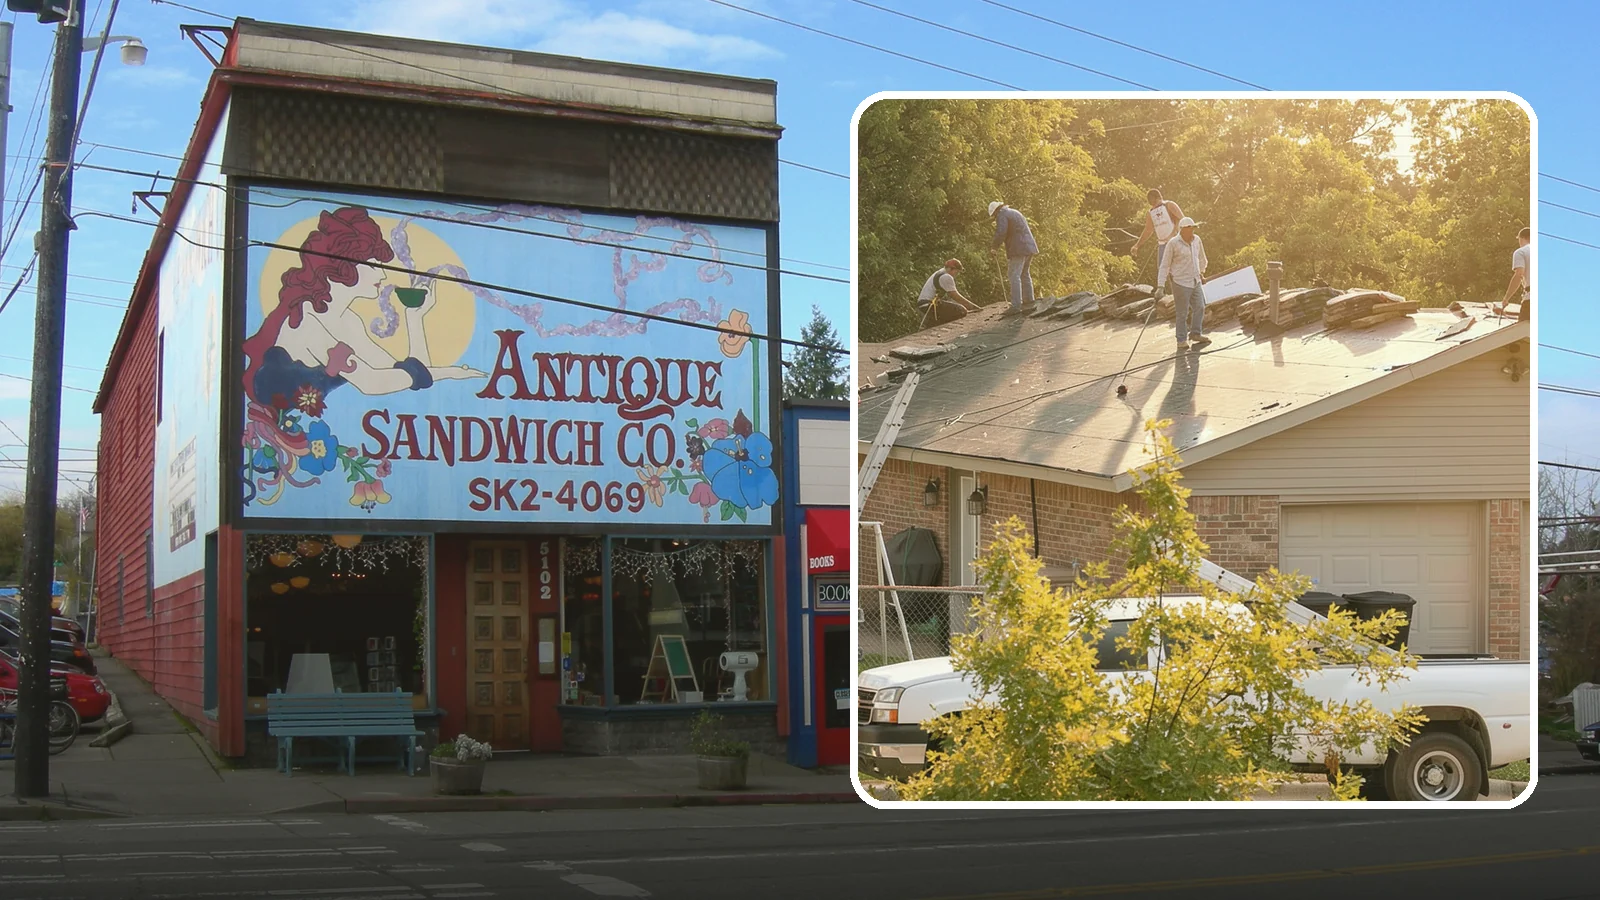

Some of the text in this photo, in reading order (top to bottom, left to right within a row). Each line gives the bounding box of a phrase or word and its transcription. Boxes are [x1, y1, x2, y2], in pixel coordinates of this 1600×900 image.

[476, 329, 724, 420] ANTIQUE
[361, 408, 685, 469] SANDWICH CO.
[468, 477, 646, 514] SK2-4069
[539, 542, 552, 600] 5102
[809, 555, 835, 569] BOOKS
